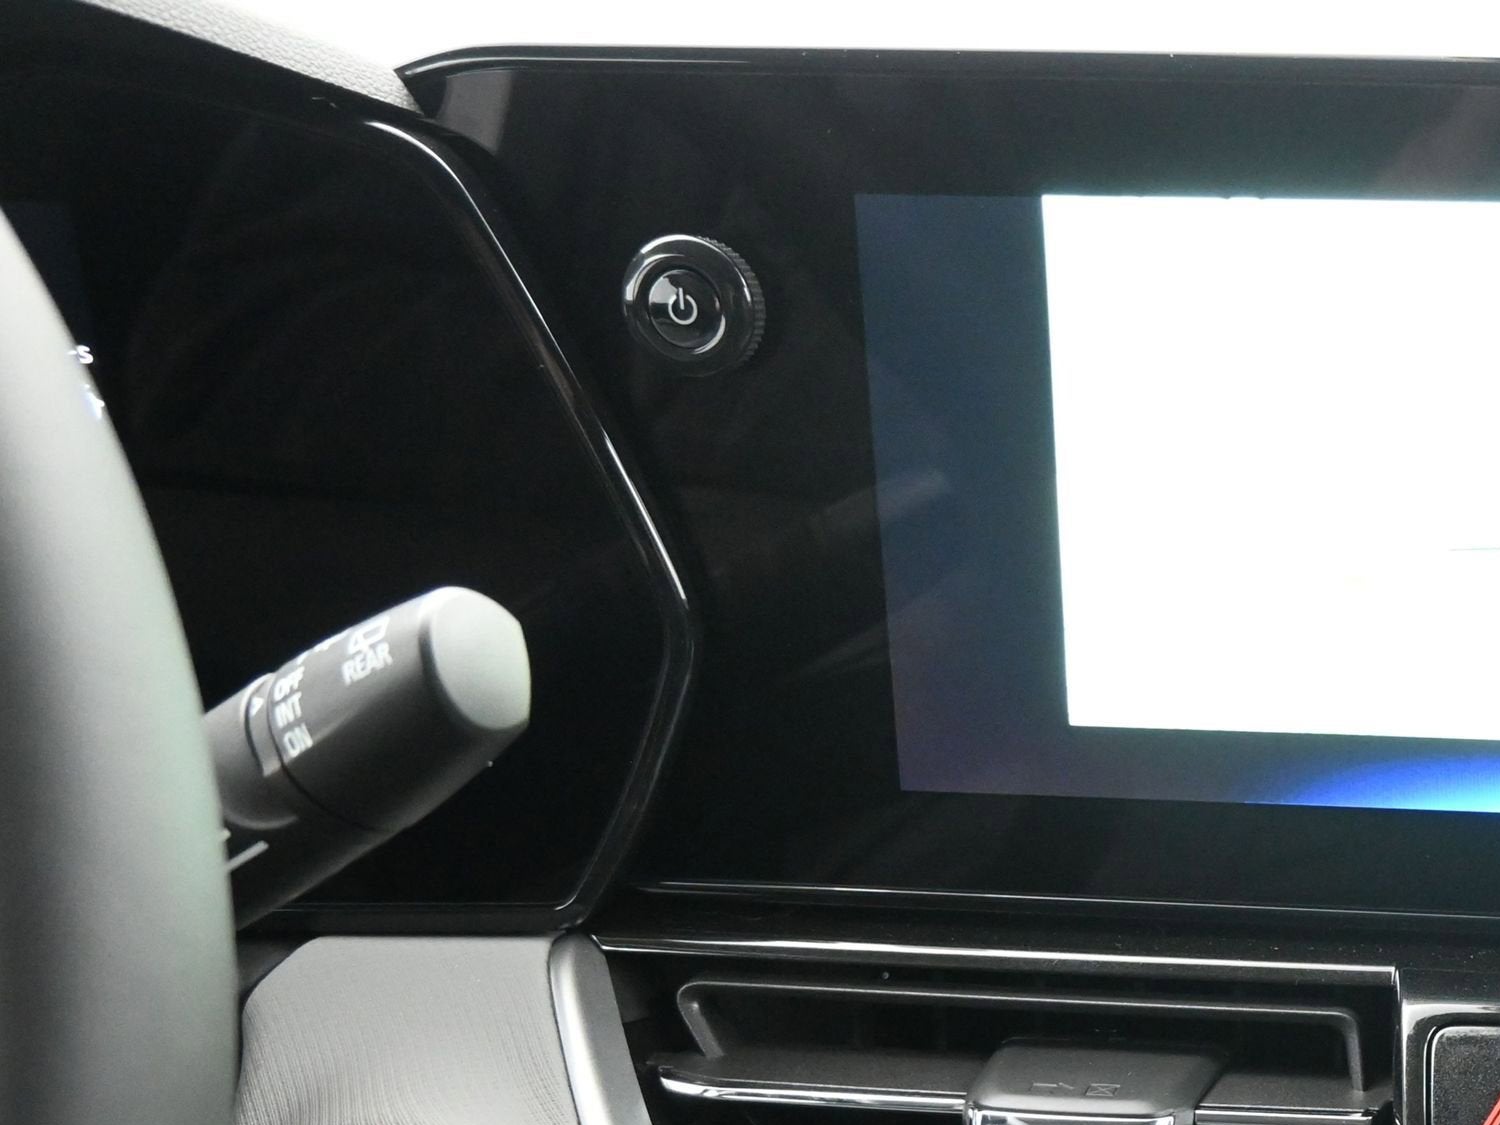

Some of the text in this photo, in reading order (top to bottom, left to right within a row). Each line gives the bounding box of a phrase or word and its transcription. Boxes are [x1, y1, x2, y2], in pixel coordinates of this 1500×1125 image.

[342, 642, 393, 686] REAR
[274, 692, 302, 728] INT
[283, 723, 313, 758] ON
